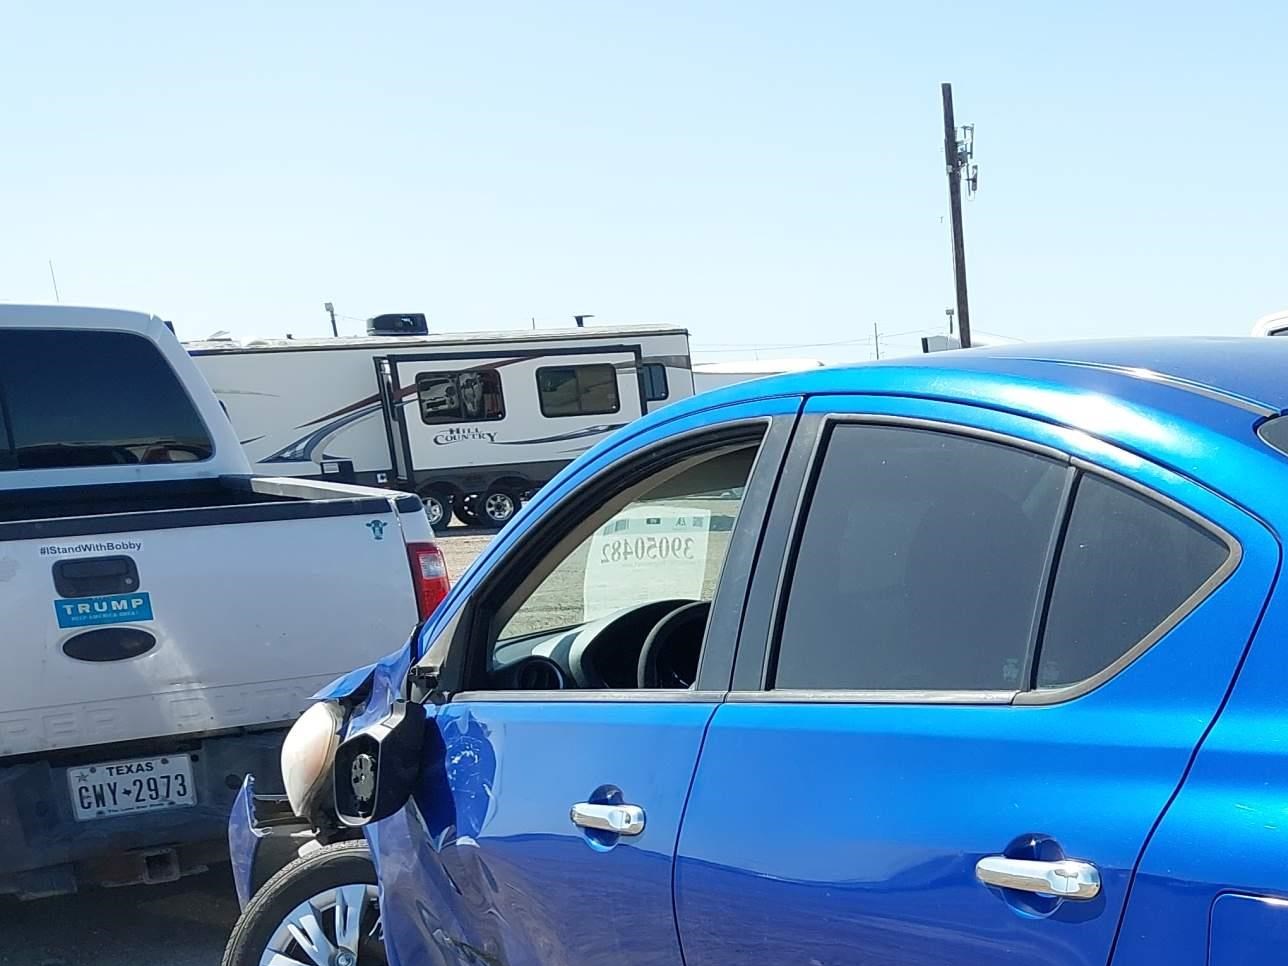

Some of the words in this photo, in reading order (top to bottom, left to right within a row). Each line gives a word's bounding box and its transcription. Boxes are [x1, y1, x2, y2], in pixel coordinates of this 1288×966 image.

[433, 431, 497, 446] COUNTRY
[40, 542, 142, 555] #IStandWithBobby
[62, 599, 144, 615] TRUMP
[106, 762, 154, 776] TEXAS
